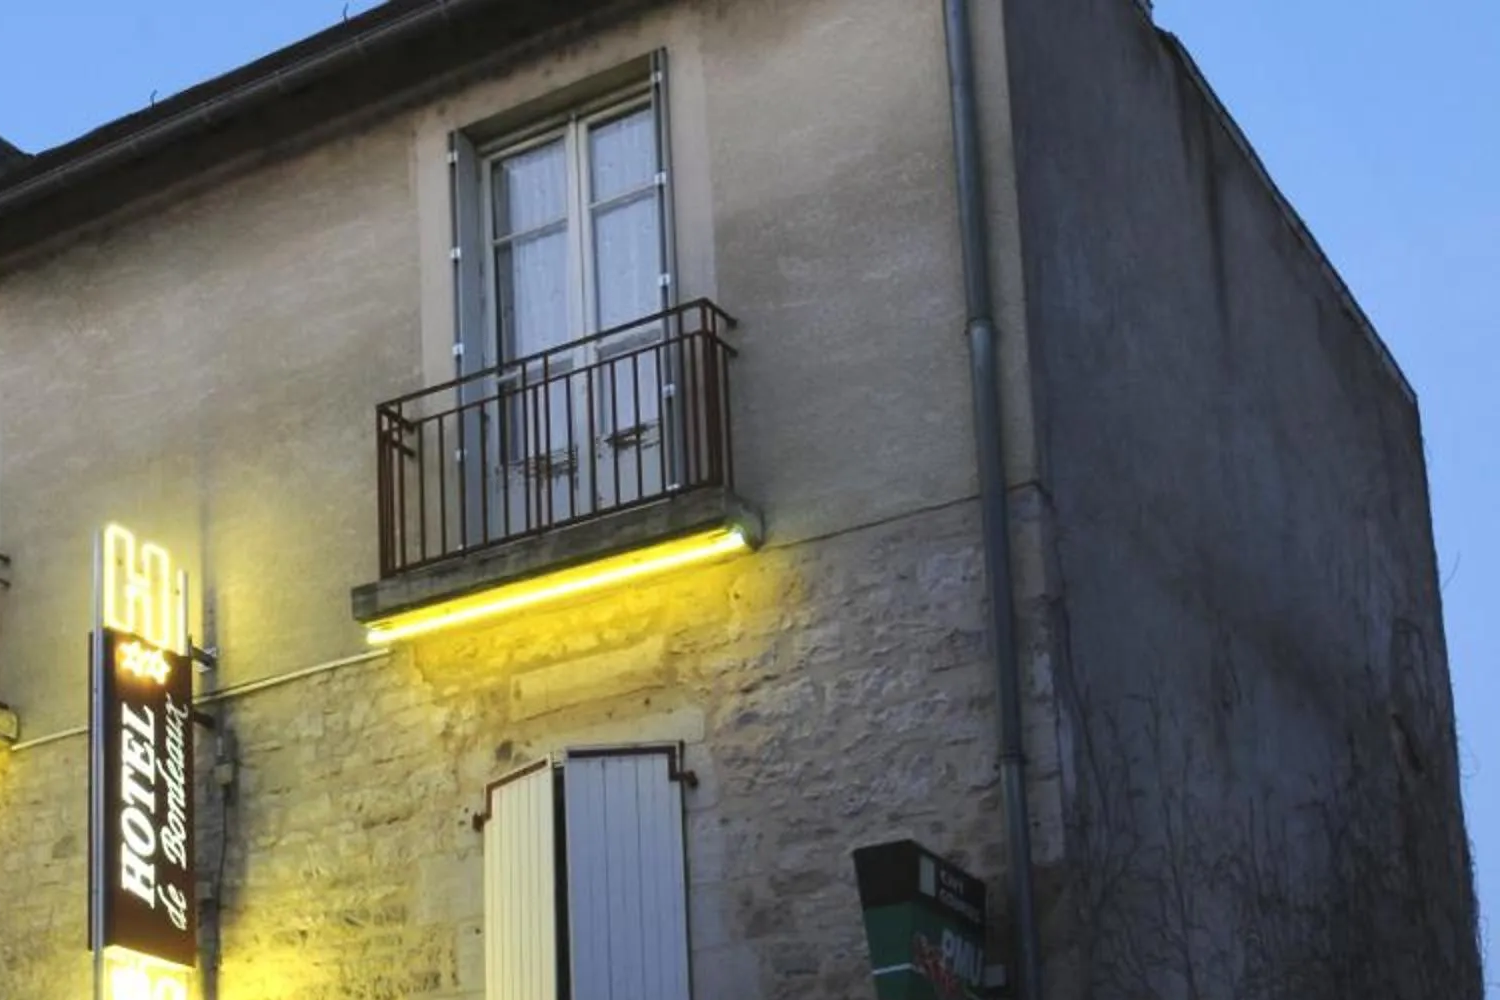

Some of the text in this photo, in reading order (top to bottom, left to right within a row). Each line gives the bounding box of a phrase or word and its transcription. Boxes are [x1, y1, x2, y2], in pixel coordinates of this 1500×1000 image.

[121, 702, 156, 909] HOTEL
[157, 692, 189, 931] de Bordeaux
[942, 928, 984, 987] PMU
